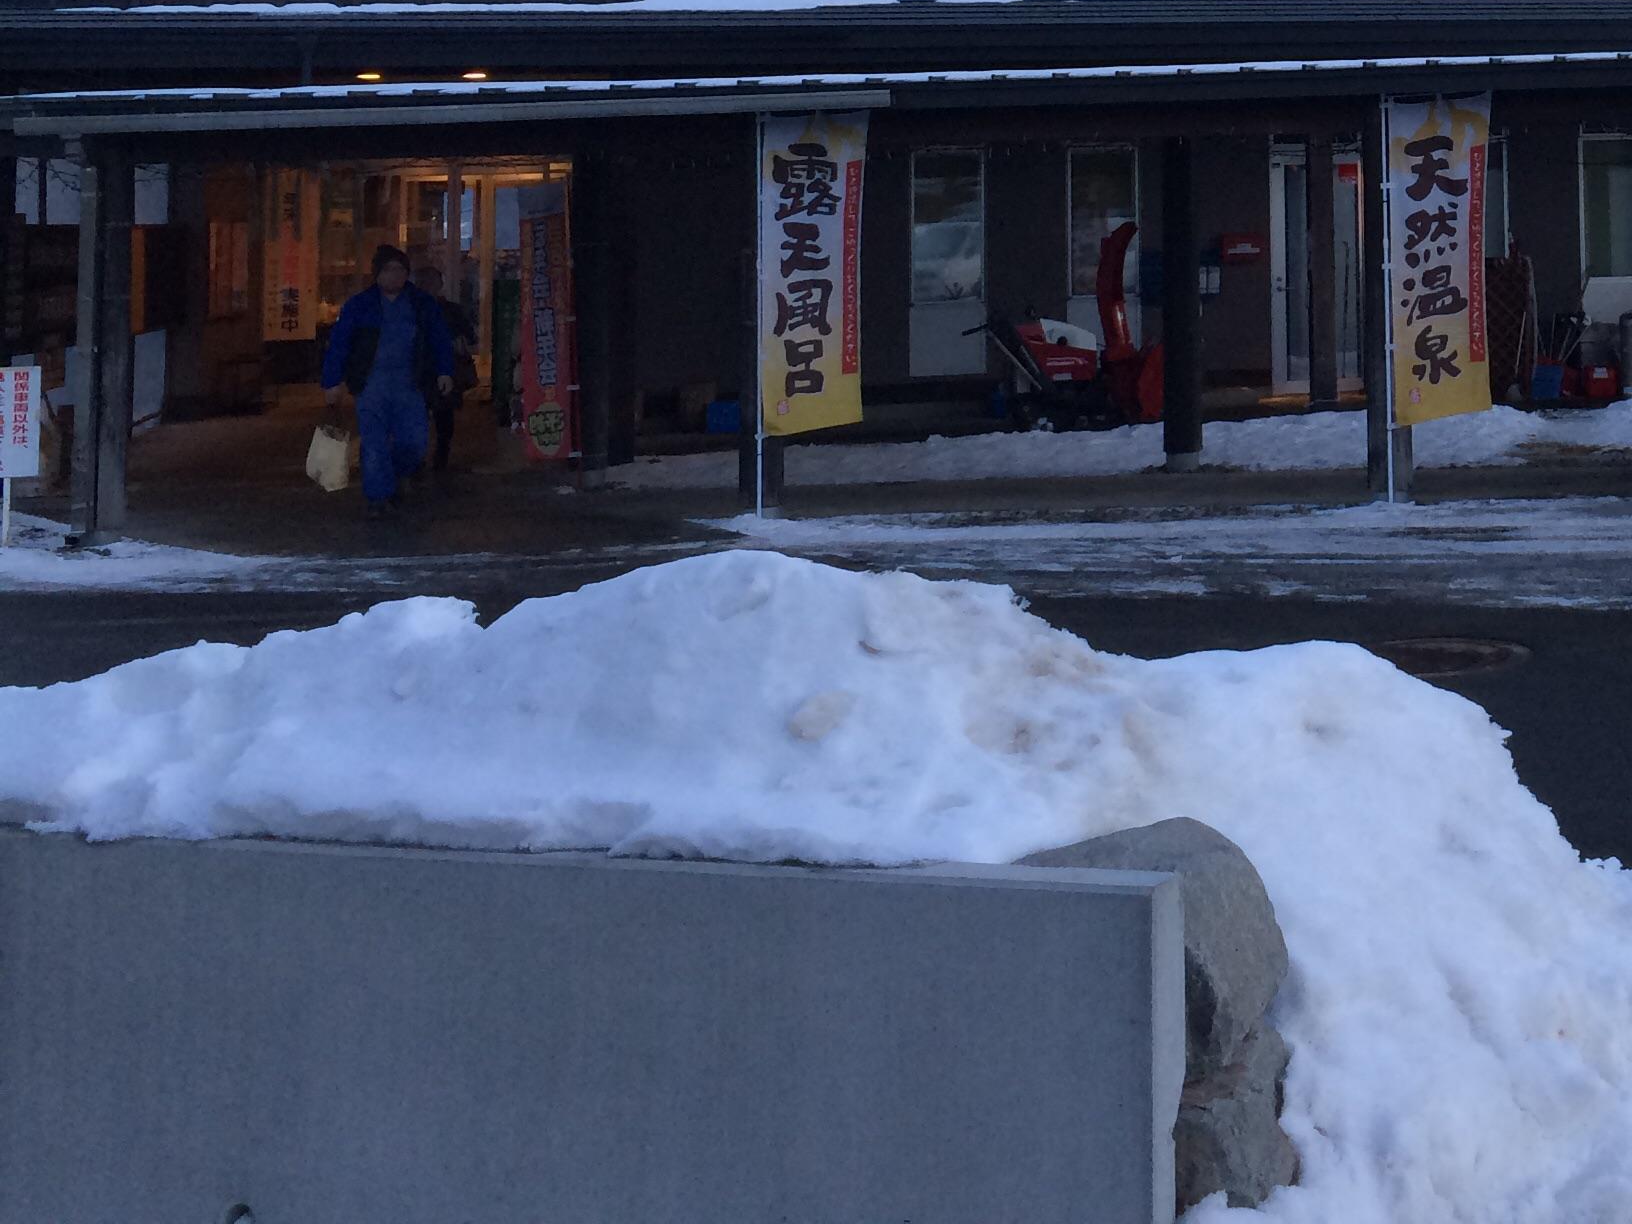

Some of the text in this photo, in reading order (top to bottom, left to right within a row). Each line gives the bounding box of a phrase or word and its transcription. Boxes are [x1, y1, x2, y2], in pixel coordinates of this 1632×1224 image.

[772, 142, 842, 398] 露天風呂
[1401, 135, 1468, 384] 天然温泉
